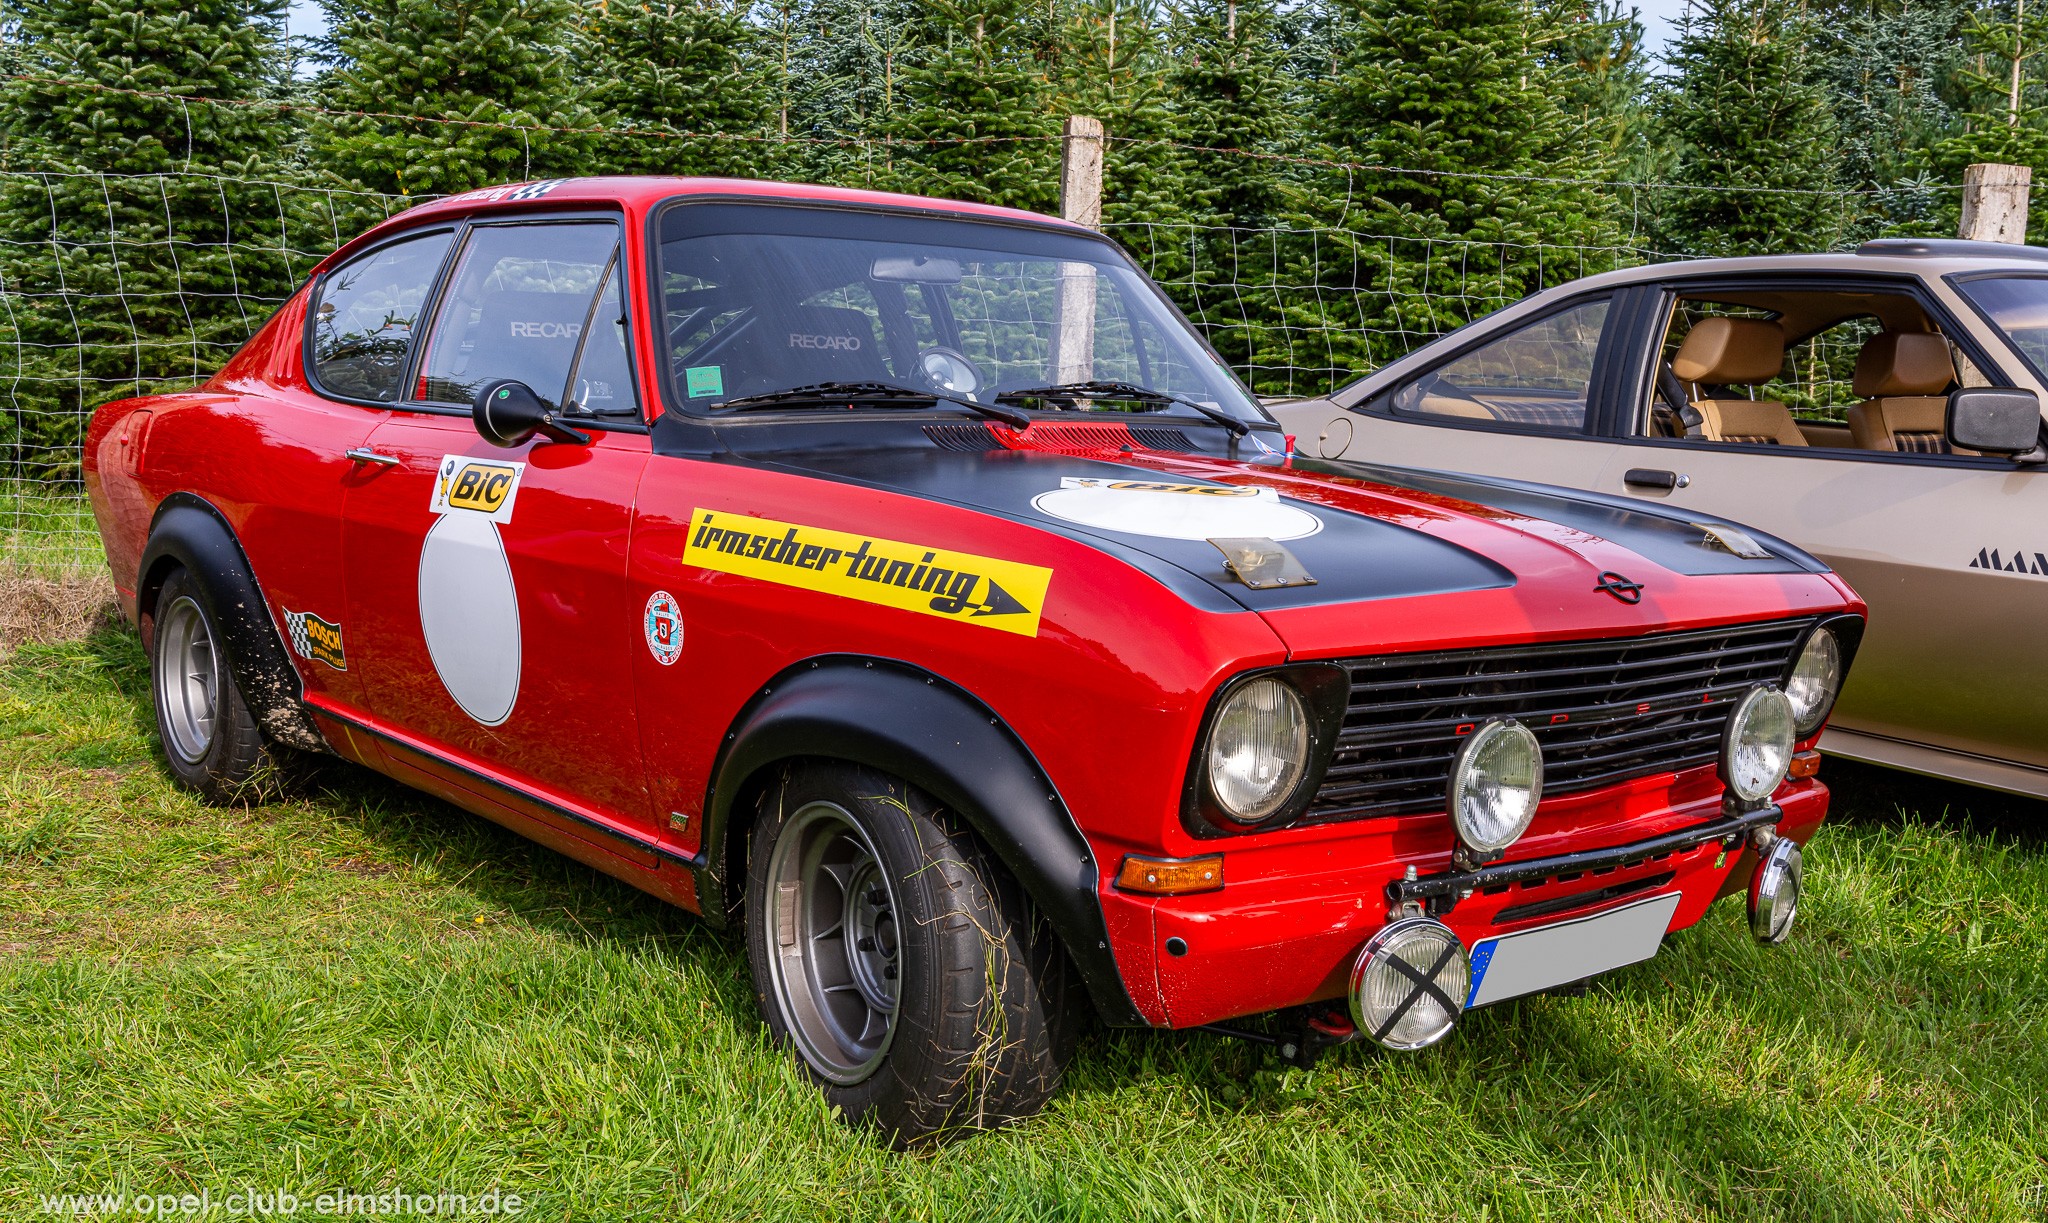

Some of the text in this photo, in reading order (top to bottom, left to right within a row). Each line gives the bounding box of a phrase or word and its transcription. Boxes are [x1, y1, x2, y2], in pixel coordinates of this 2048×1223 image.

[789, 333, 861, 351] RECARO
[692, 514, 981, 614] irmscher tuning
[306, 619, 341, 650] BOSCH
[313, 646, 345, 667] SPARK PLUGS
[1455, 693, 1714, 736] OPEL
